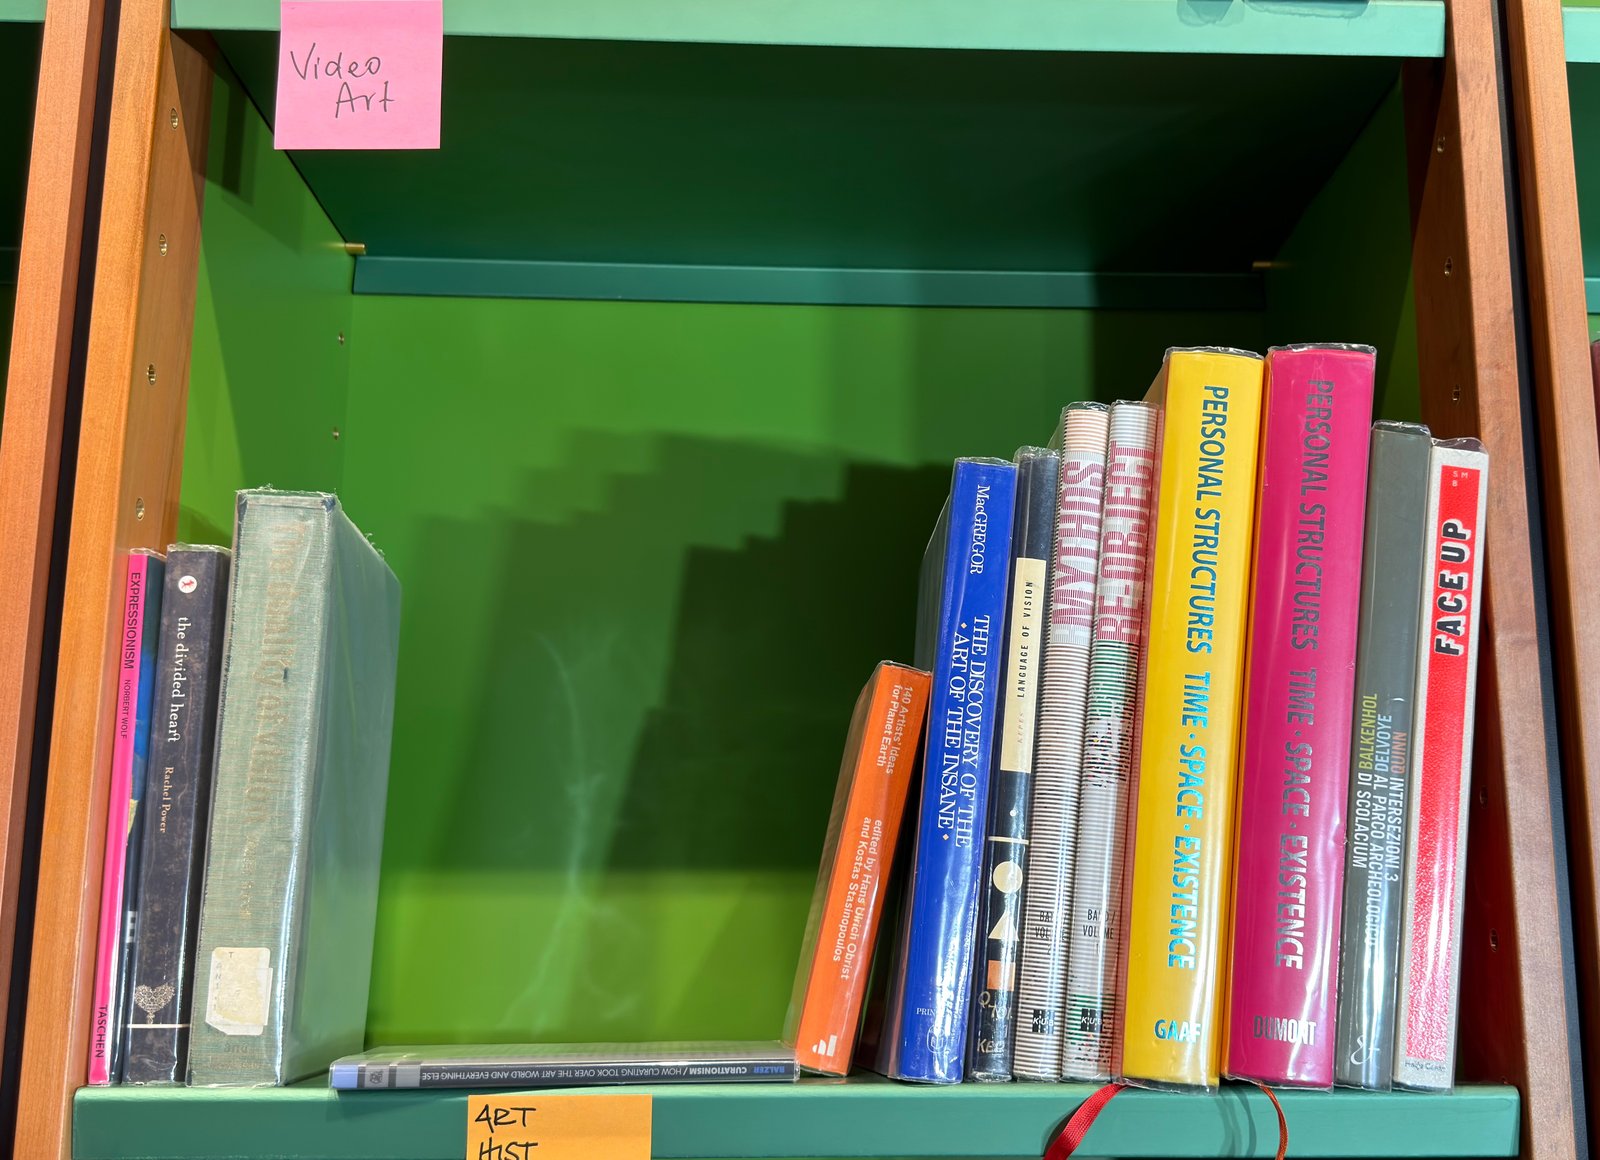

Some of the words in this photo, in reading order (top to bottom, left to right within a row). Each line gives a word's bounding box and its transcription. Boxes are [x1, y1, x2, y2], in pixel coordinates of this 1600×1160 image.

[290, 42, 381, 80] Video
[335, 81, 395, 118] Art
[1196, 385, 1230, 502] PERSONAL
[1300, 379, 1335, 497] PERSONAL
[970, 484, 992, 575] MacGREGOR
[1053, 461, 1103, 629] MYTHOS
[1097, 443, 1154, 642] RE-OBJECT
[1440, 518, 1472, 564] UP
[1186, 506, 1222, 654] STRUCTURES
[1291, 503, 1326, 652] STRUCTURES
[1023, 582, 1033, 618] VISION
[1434, 569, 1469, 656] FACE
[124, 572, 141, 669] EXPRESSIONISM
[176, 617, 191, 639] the
[971, 614, 990, 656] THE
[1022, 625, 1030, 638] OF
[172, 643, 189, 698] divided
[951, 631, 970, 674] ART
[1017, 644, 1028, 698] LANGUAGE
[122, 679, 130, 717] NORBERT
[892, 684, 903, 700] for
[901, 686, 914, 704] 140
[950, 675, 966, 702] OF
[1182, 672, 1211, 728] TIME
[1286, 666, 1316, 727] TIME
[120, 718, 128, 739] WOLF
[167, 702, 184, 743] heart
[884, 700, 900, 735] Planet
[944, 708, 964, 748] THE
[962, 661, 986, 770] DISCOVERY
[1358, 694, 1378, 770] BALKENHOL
[876, 736, 892, 767] Earth
[886, 746, 900, 774] Ideas
[1374, 714, 1392, 772] DELVOYE
[1390, 732, 1408, 774] QUINN
[162, 766, 174, 802] Rachel
[938, 752, 960, 830] INSANE
[960, 772, 977, 801] OF
[1176, 738, 1207, 820] SPACE
[1279, 742, 1313, 818] SPACE
[1356, 772, 1372, 786] DI
[1373, 774, 1387, 790] AL
[159, 804, 171, 833] Power
[860, 816, 872, 838] and
[956, 805, 974, 848] THE
[1352, 789, 1372, 869] SCOLACIUM
[1370, 796, 1386, 840] PARCO
[1385, 778, 1404, 870] INTERSEZIONI
[870, 819, 882, 858] edited
[851, 840, 868, 880] Kostas
[864, 857, 876, 872] by
[1384, 873, 1398, 882] 3
[858, 874, 872, 904] Hans
[1168, 835, 1202, 970] EXISTENCE
[1274, 834, 1308, 970] EXISTENCE
[833, 882, 858, 962] Stasinopoulos
[850, 906, 865, 940] Ulrich
[840, 942, 857, 980] Obrist
[95, 1004, 108, 1058] TASCHEN
[1154, 1019, 1201, 1044] GAAF
[1254, 1015, 1317, 1046] DUMONT
[422, 1072, 440, 1080] ELSE
[440, 1071, 490, 1080] EVERYTHING
[491, 1070, 510, 1079] AND
[510, 1070, 541, 1078] WORLD
[541, 1070, 556, 1078] ART
[558, 1069, 574, 1078] THE
[574, 1068, 596, 1078] OVER
[597, 1068, 620, 1077] TOOK
[621, 1068, 660, 1076] CURATING
[661, 1066, 682, 1076] HOW
[689, 1066, 748, 1076] CURATIONISM
[753, 1066, 786, 1074] BALZER
[475, 1103, 537, 1134] ART
[478, 1136, 538, 1160] HIST
